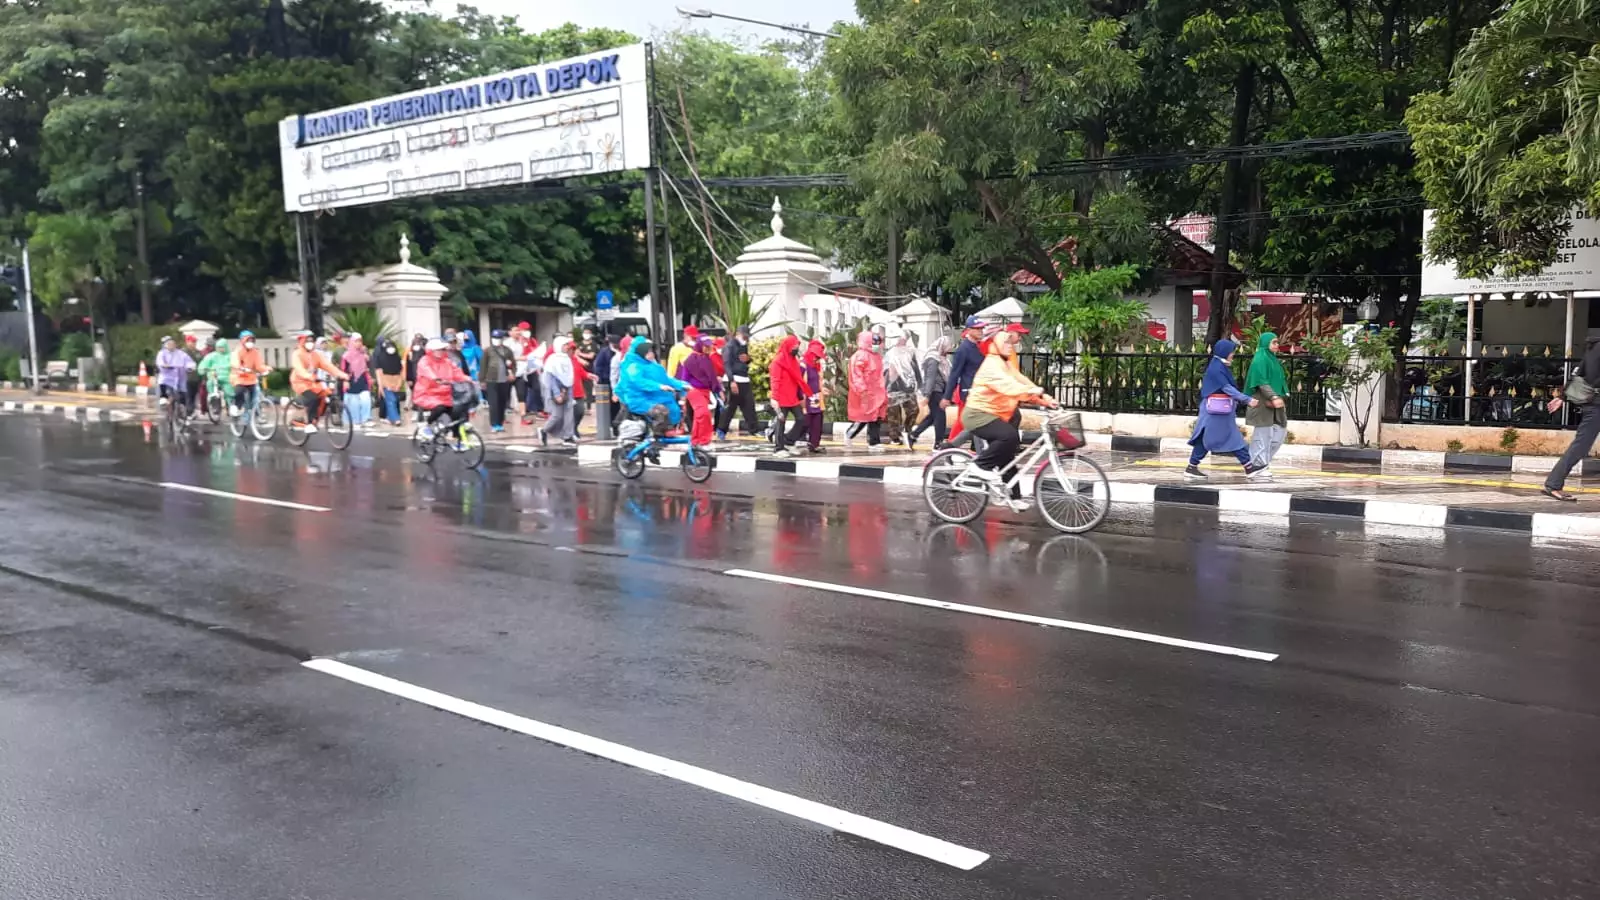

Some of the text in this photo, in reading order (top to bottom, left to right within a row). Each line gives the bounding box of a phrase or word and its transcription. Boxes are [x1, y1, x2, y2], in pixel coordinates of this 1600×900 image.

[305, 108, 369, 138] KANTOR
[371, 84, 481, 126] PEMERINTAH
[484, 72, 542, 104] KOTA
[545, 54, 621, 93] DEPOK
[1557, 238, 1600, 249] GELOLA
